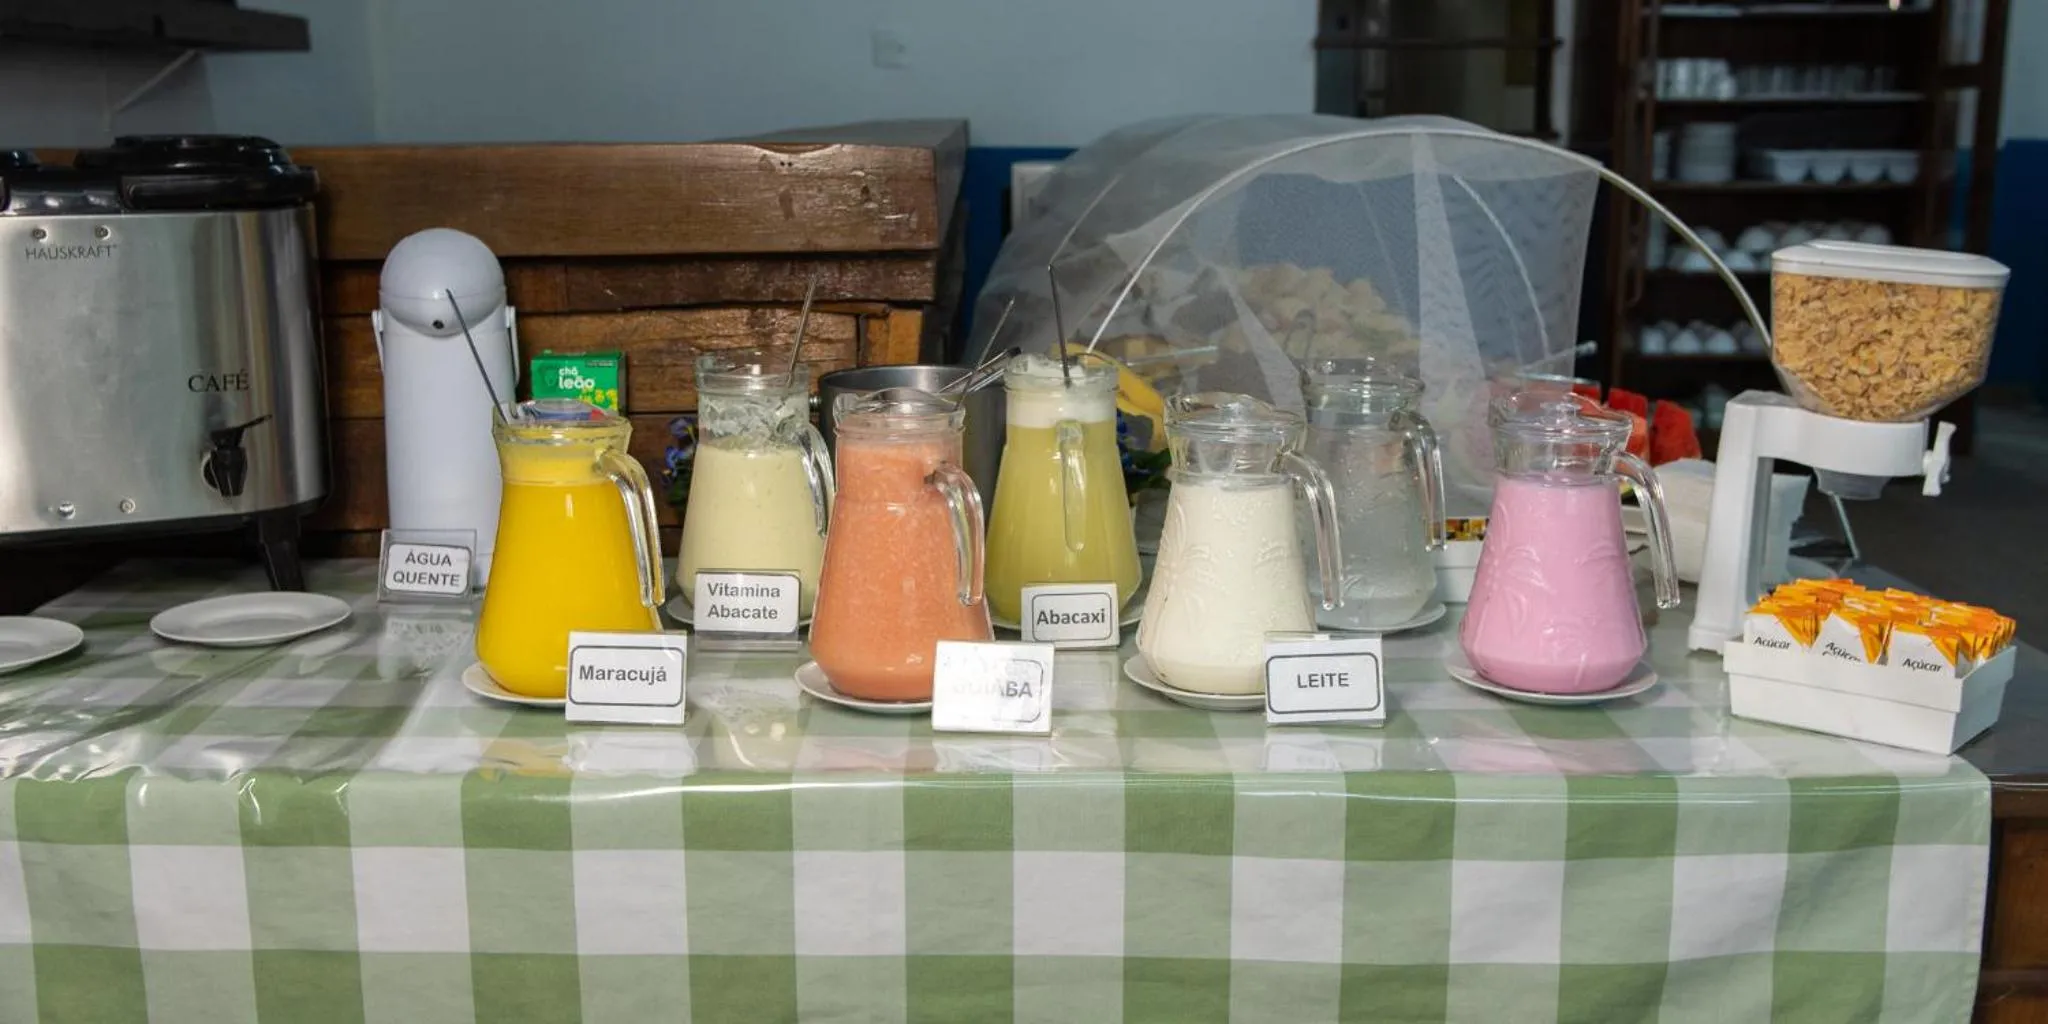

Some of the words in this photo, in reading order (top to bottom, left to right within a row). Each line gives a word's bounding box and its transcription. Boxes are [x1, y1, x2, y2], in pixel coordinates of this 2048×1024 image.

[25, 245, 112, 260] HAUSKRAFT
[188, 368, 250, 393] CAFÉ
[405, 549, 452, 567] ÁGUA
[393, 570, 460, 587] QUENTE
[707, 582, 781, 598] Vitamina
[707, 604, 778, 620] Abacate
[1036, 608, 1105, 626] Abacaxi
[579, 664, 667, 686] Maracujá
[1297, 672, 1350, 689] LEITE
